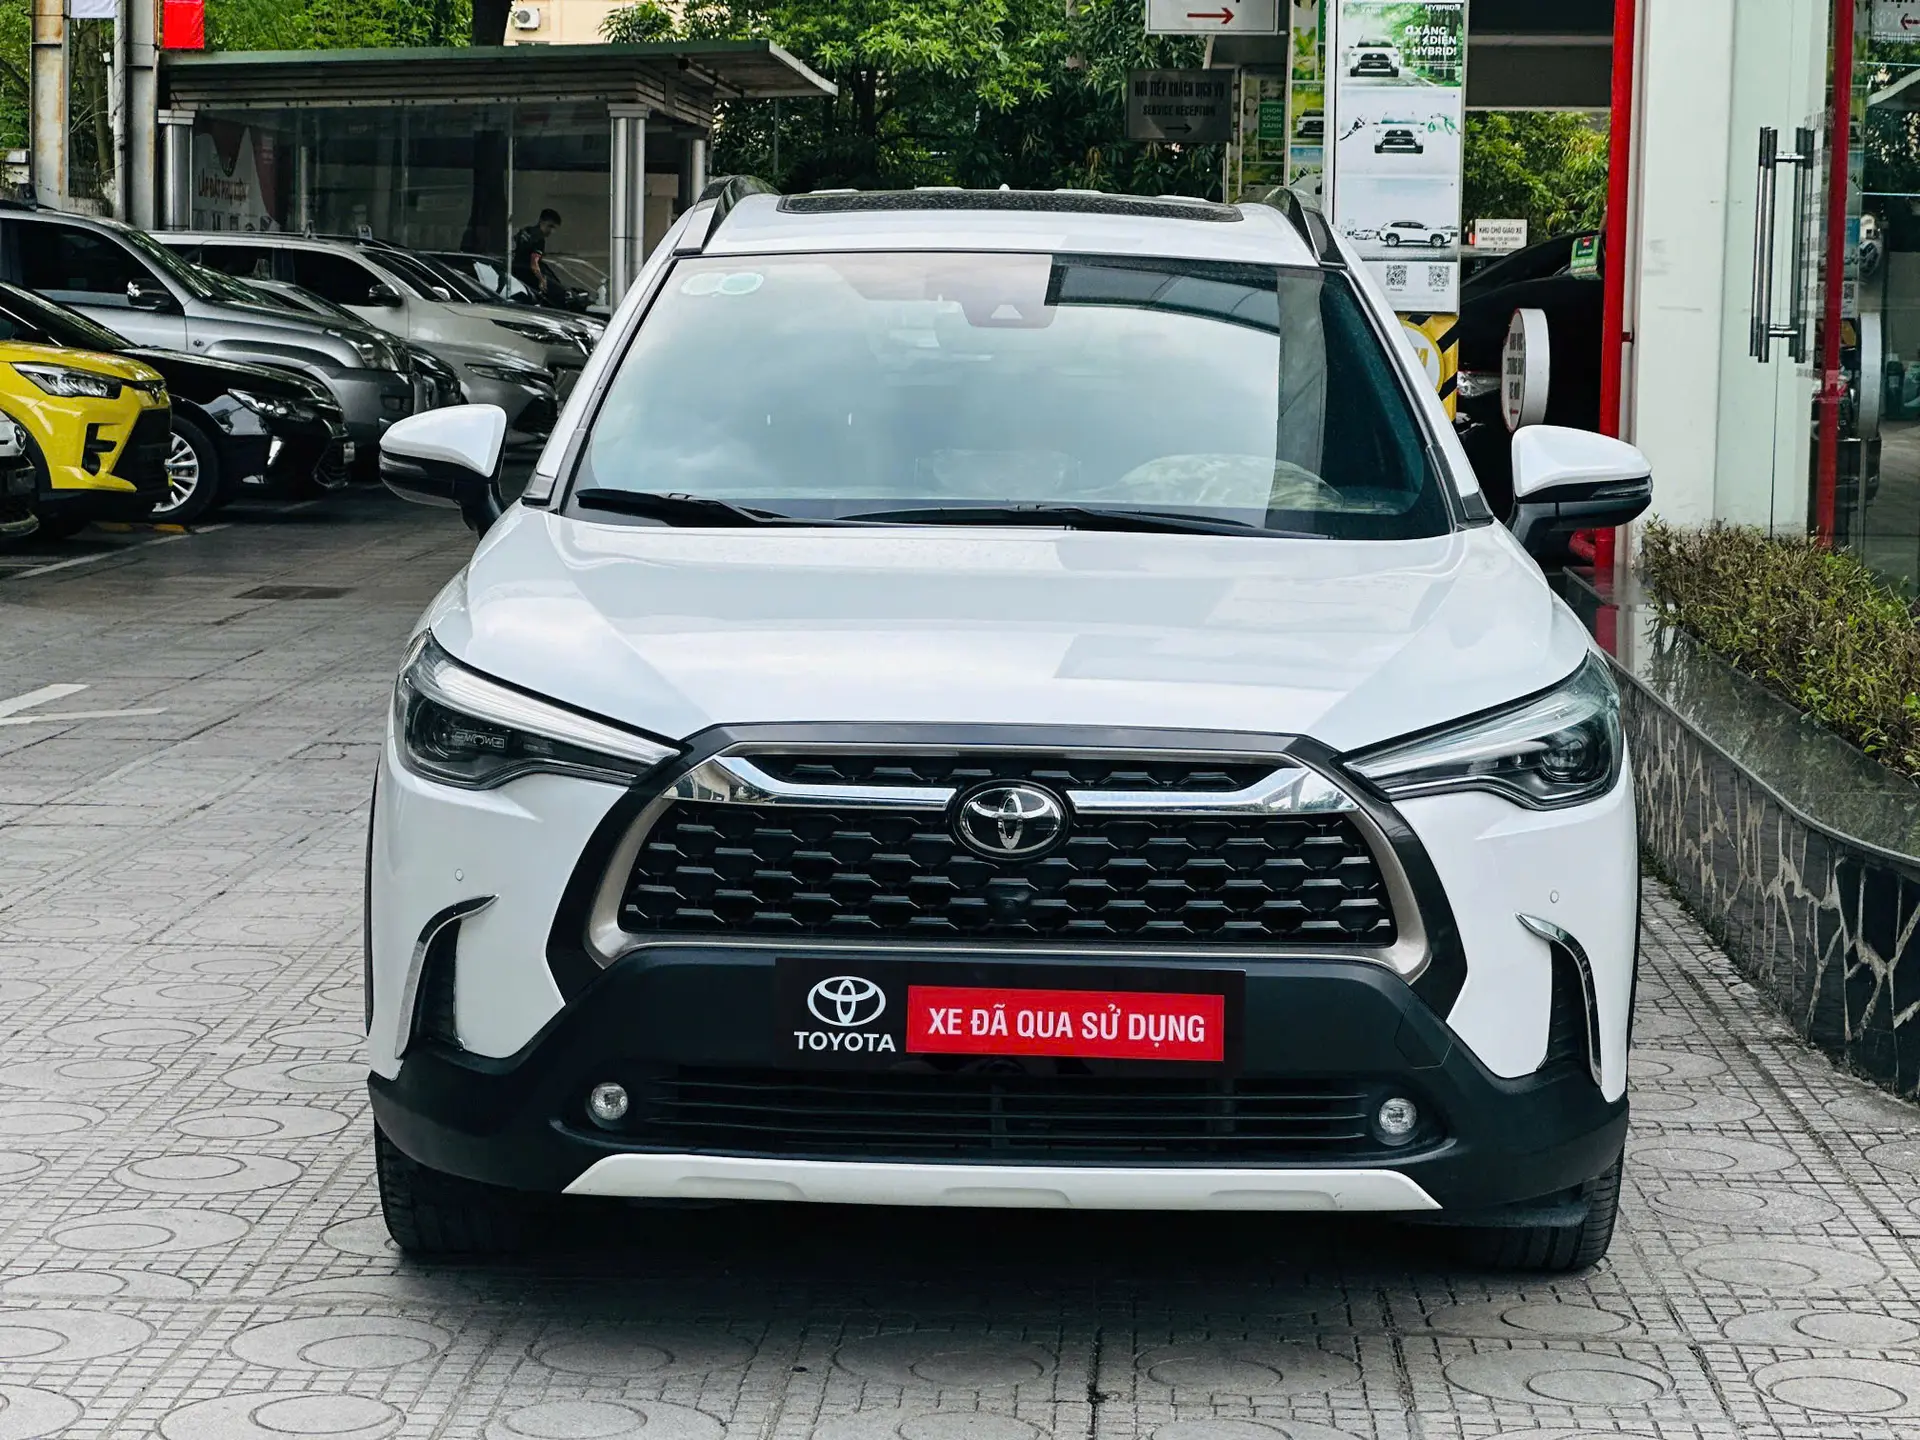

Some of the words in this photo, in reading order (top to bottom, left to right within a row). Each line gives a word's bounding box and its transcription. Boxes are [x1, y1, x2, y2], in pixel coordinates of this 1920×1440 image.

[1412, 46, 1457, 56] HYBRID!
[927, 1007, 963, 1035] XE
[970, 1003, 1008, 1036] ĐÃ
[1016, 1010, 1073, 1039] QUA
[1081, 1003, 1121, 1040] SỬ
[1128, 1013, 1205, 1048] DỤNG
[794, 1031, 897, 1052] TOYOTA
